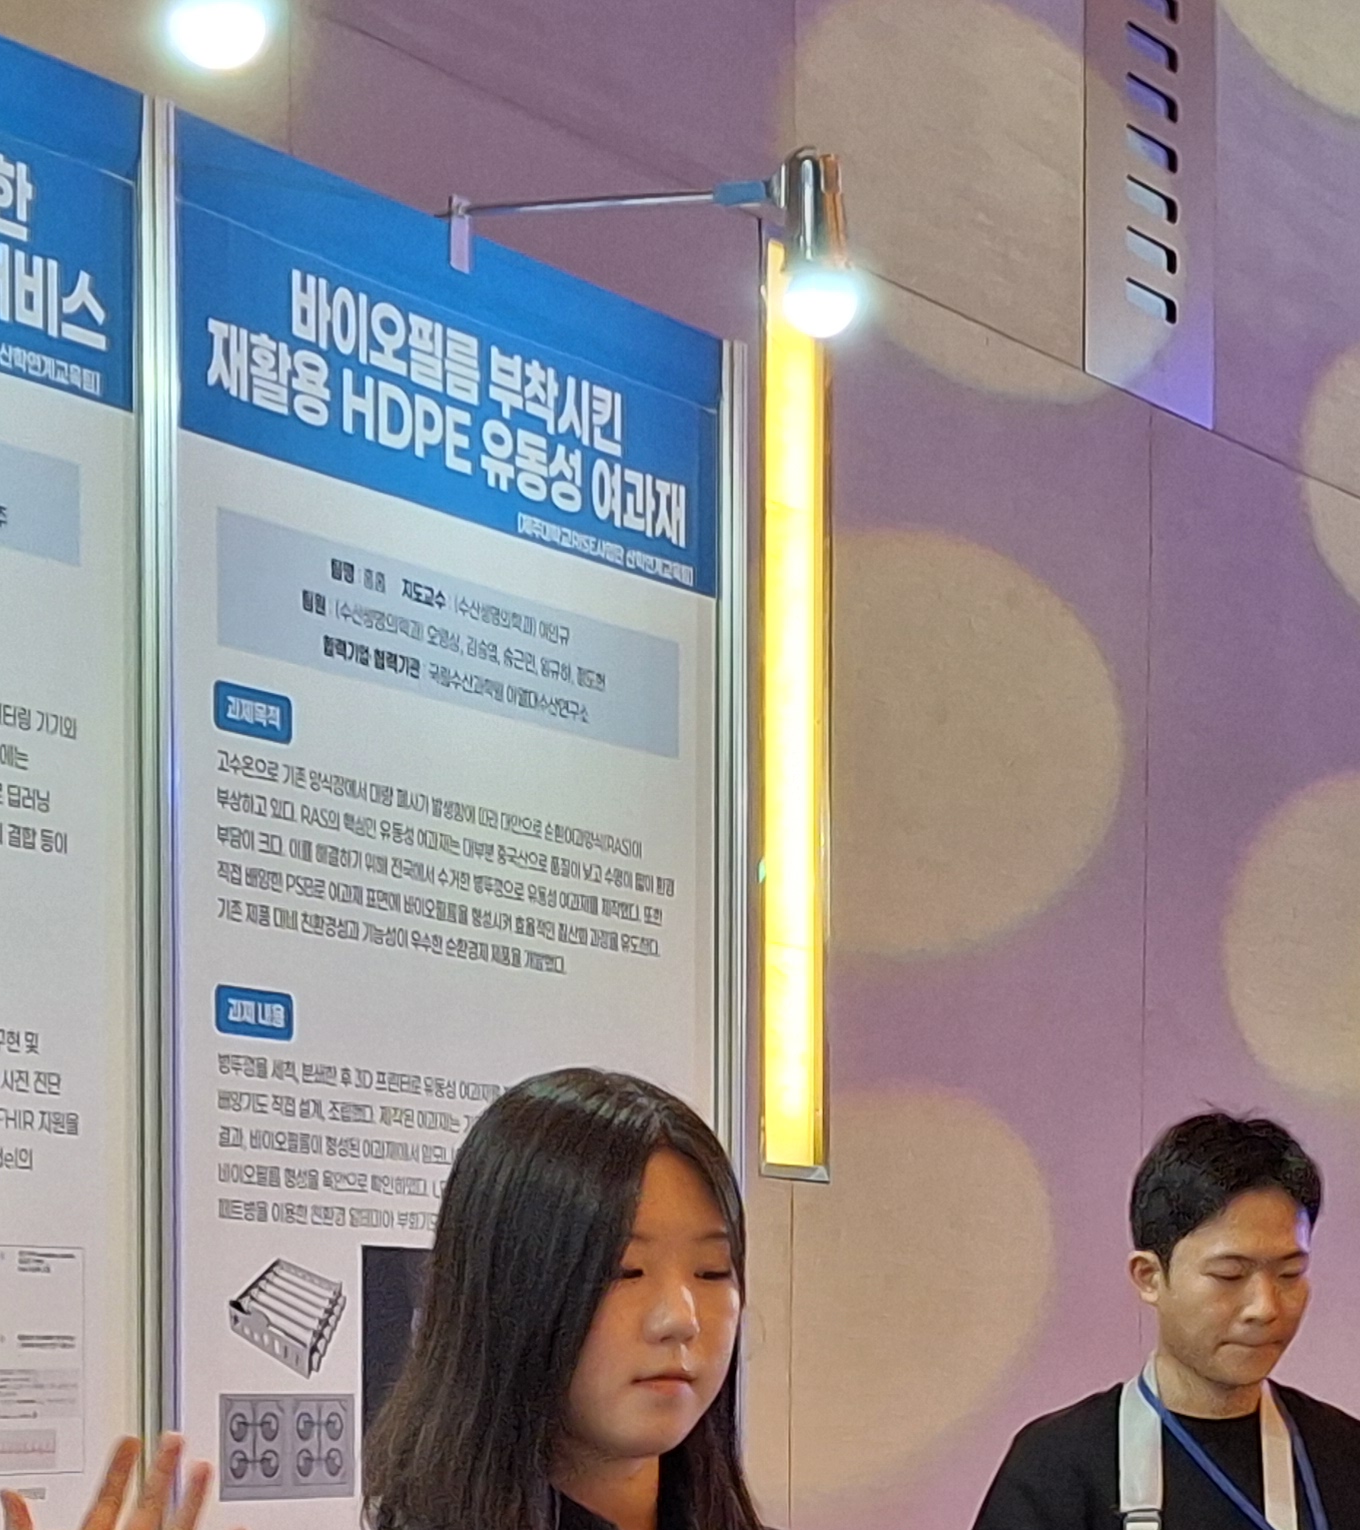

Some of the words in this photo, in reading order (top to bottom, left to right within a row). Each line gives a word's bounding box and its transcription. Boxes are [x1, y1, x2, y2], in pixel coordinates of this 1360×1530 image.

[292, 269, 478, 406] 바이오필름
[488, 344, 622, 457] 부착시킨
[208, 318, 328, 426] 재활용
[343, 368, 471, 475] HDPE
[481, 419, 581, 513] 유동성
[592, 458, 685, 548] 여과재
[402, 578, 445, 609] 지도교수
[218, 749, 278, 783] 고수온으로
[283, 764, 306, 789] 기존
[7, 784, 50, 814] 딥러닝
[301, 804, 340, 831] RAS의
[8, 823, 36, 850] 결합
[41, 828, 67, 854] 등이
[25, 1031, 38, 1054] 및
[1, 1069, 29, 1093] 사전
[34, 1071, 61, 1096] 진단
[38, 1110, 78, 1136] 지원을
